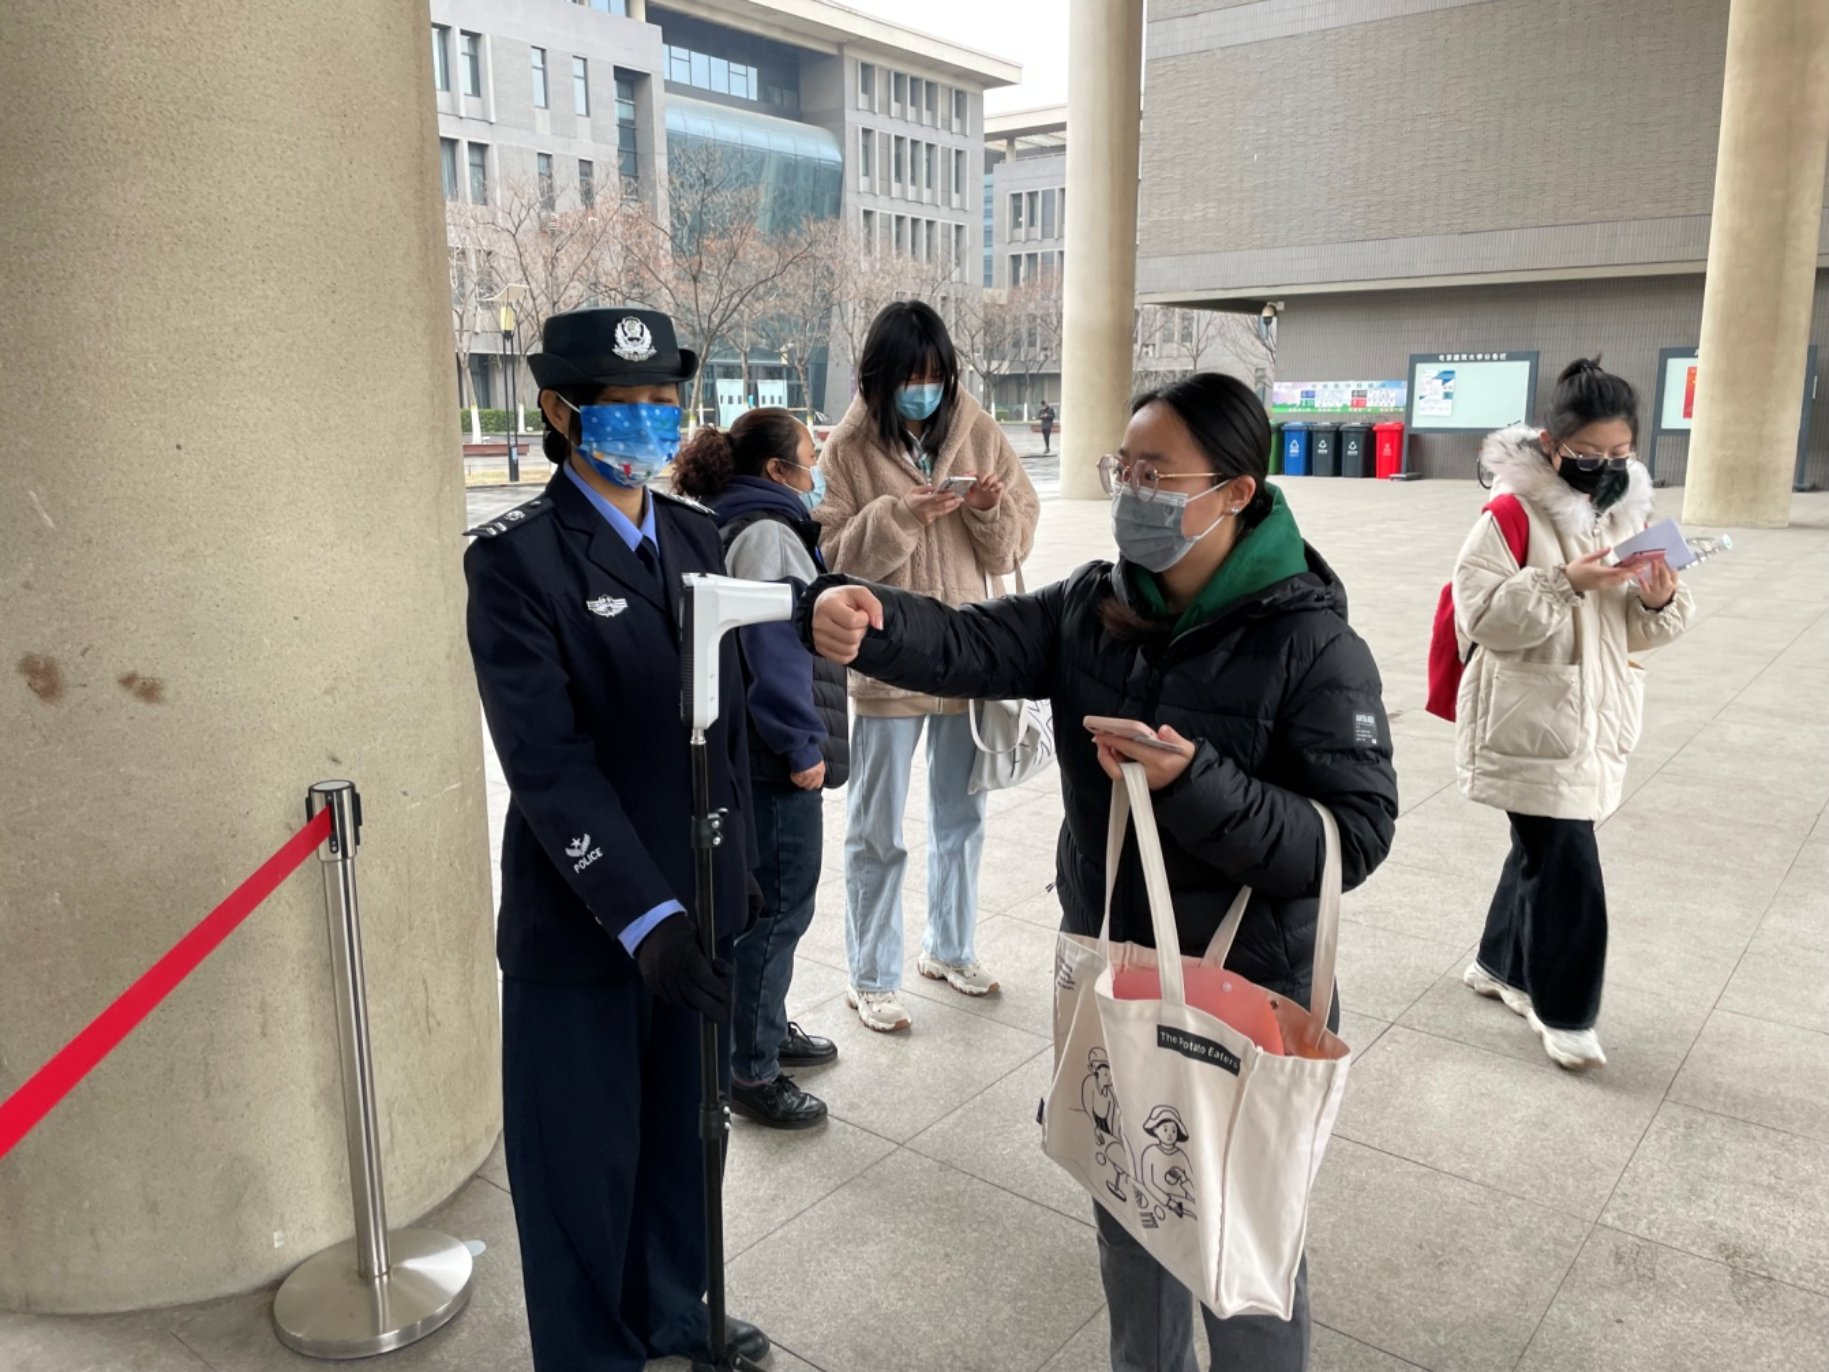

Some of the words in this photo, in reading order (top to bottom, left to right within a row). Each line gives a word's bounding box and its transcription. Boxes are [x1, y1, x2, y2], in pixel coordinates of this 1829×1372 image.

[573, 846, 604, 874] POLICE
[1160, 1031, 1178, 1044] The
[1179, 1037, 1207, 1054] Potato
[1208, 1047, 1238, 1069] Eaters
